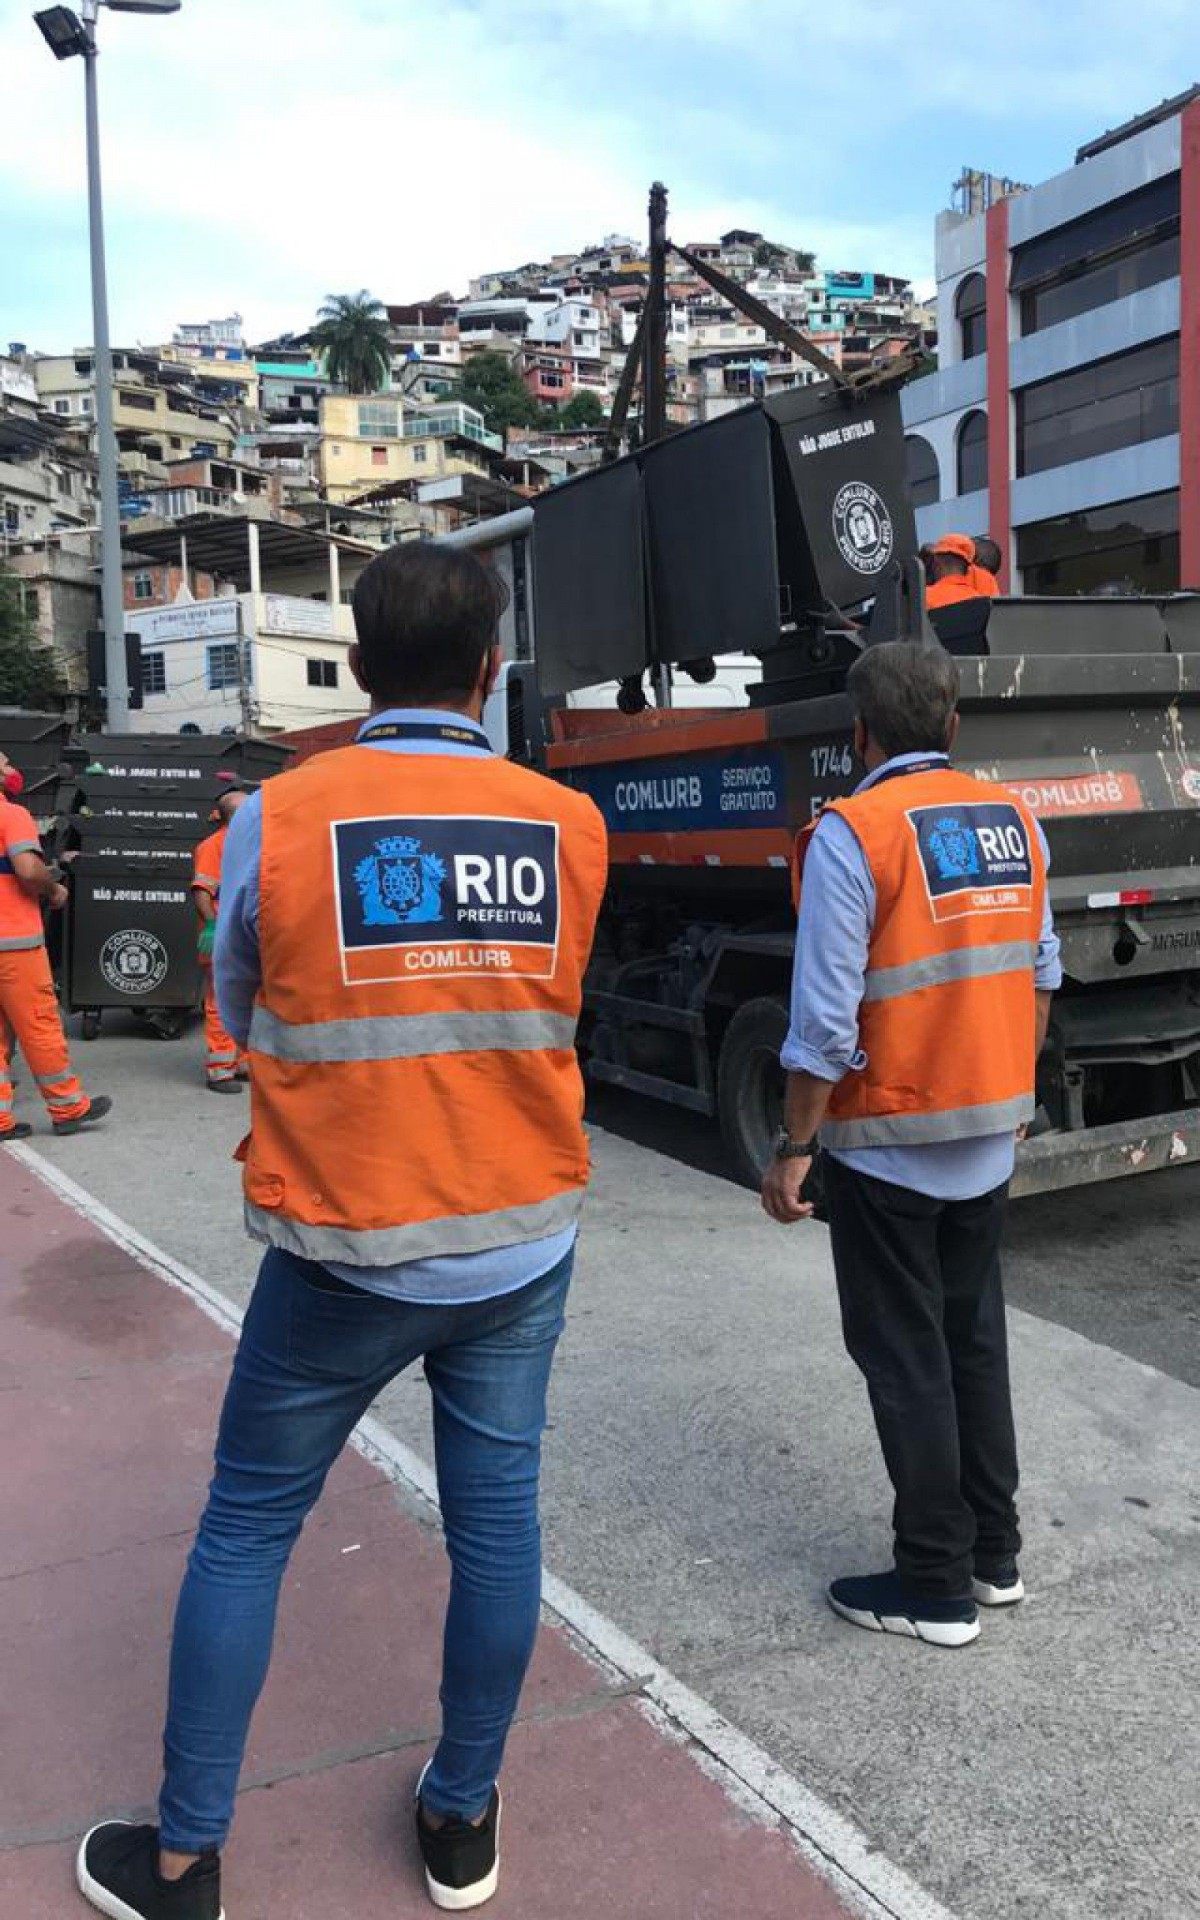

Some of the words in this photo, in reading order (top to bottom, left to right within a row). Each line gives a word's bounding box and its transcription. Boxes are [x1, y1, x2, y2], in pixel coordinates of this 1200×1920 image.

[799, 434, 817, 455] NÃO
[836, 485, 877, 518] COMLURB
[810, 745, 852, 777] 1746
[722, 765, 772, 789] SERVIÇO
[615, 775, 702, 811] COMLURB
[720, 790, 775, 811] GRATUITO
[976, 825, 1025, 861] RIO
[453, 854, 545, 906] RIO
[93, 886, 112, 901] NÃO
[114, 889, 143, 901] JOGUE
[145, 890, 187, 903] ENTULHO
[457, 908, 542, 925] PREFEITURA
[107, 933, 158, 952] COMLURB
[404, 949, 512, 970] COMLURB
